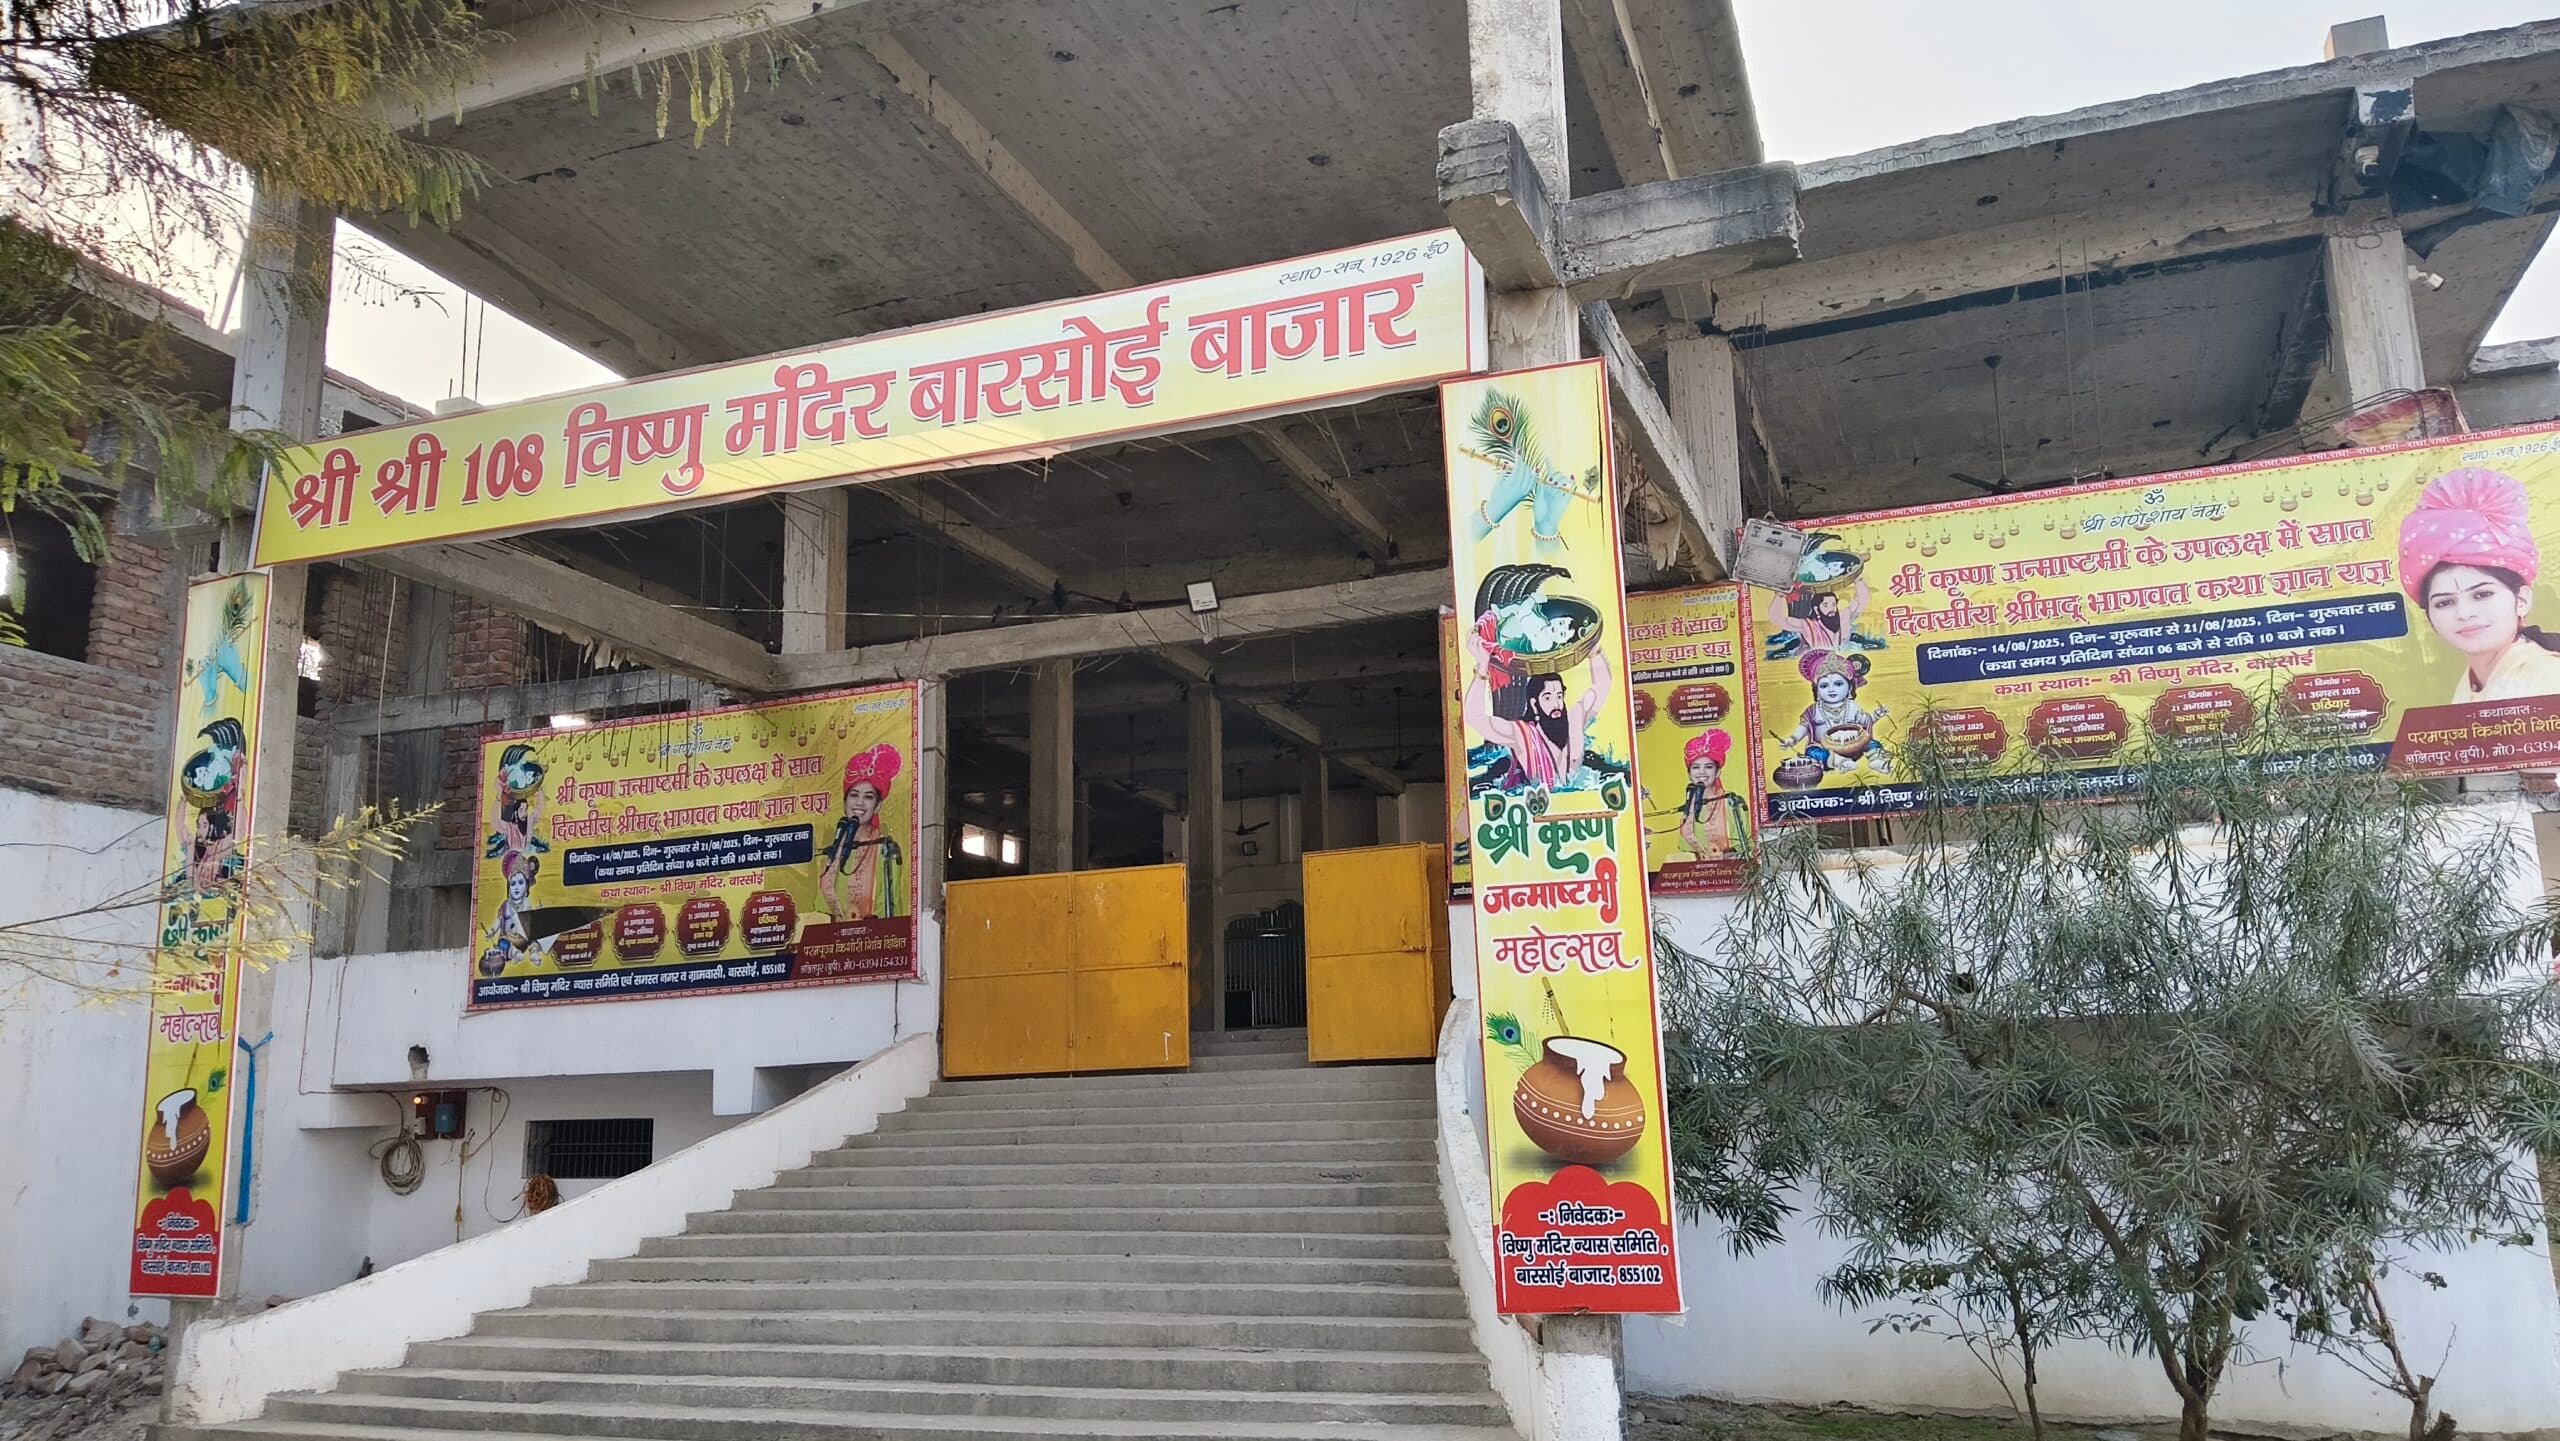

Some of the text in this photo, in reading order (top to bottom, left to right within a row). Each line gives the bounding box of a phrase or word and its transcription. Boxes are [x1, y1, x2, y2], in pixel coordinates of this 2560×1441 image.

[1370, 247, 1418, 271] 1926
[289, 273, 1424, 529] श्री श्री 108 विष्णु मंदिर बारसोई बाजार
[2082, 502, 2227, 532] श्री गणेशाय नमः
[2144, 488, 2165, 505] ॐ
[1890, 518, 2374, 597] श्री कृष्ण जन्माष्टमी के उपलक्ष में सात
[1886, 559, 2392, 637] दिवसीय श्रीमद् भागवत कथा ज्ञान यज्ञ
[1671, 616, 1685, 636] में
[1686, 617, 1726, 636] सात
[1992, 638, 2065, 655] 14/08/2025,
[2165, 622, 2180, 635] से
[2184, 616, 2262, 634] 21/08/2025,
[2367, 600, 2397, 614] तक
[1666, 645, 1698, 663] ज्ञान
[1702, 640, 1732, 658] यज्ञ
[1979, 659, 2017, 676] (कथा
[2019, 655, 2057, 669] समय
[2060, 648, 2114, 665] प्रतिदिन
[2157, 644, 2173, 655] 06
[2176, 637, 2202, 652] बजे
[2206, 636, 2221, 650] से
[2224, 632, 2254, 648] रात्रि
[2259, 633, 2274, 644] 10
[2277, 626, 2304, 641] बजे
[1993, 683, 2033, 697] कथा
[2109, 667, 2132, 684] श्री
[2138, 665, 2182, 684] विष्णु
[2186, 659, 2240, 677] मंदिर,
[2408, 719, 2527, 747] परमपूज्य किशोरी
[556, 752, 825, 809] श्री कृष्ण जन्माष्टमी के उपलक्ष में सात
[1857, 790, 1877, 807] श्री
[1879, 788, 1915, 808] विष्णु
[551, 790, 832, 841] दिवसीय श्रीमद् भागवत कथा ज्ञान यज्ञ
[1477, 803, 1618, 874] श्री कृष्ण
[1483, 857, 1618, 924] जन्माष्टमी
[1493, 925, 1640, 974] महोत्सव
[1502, 1232, 1534, 1263] विष्णु
[1536, 1231, 1572, 1255] मंदिर
[1573, 1236, 1611, 1254] न्यास
[1516, 1262, 1662, 1288] बारसोई बाजार, 855102
